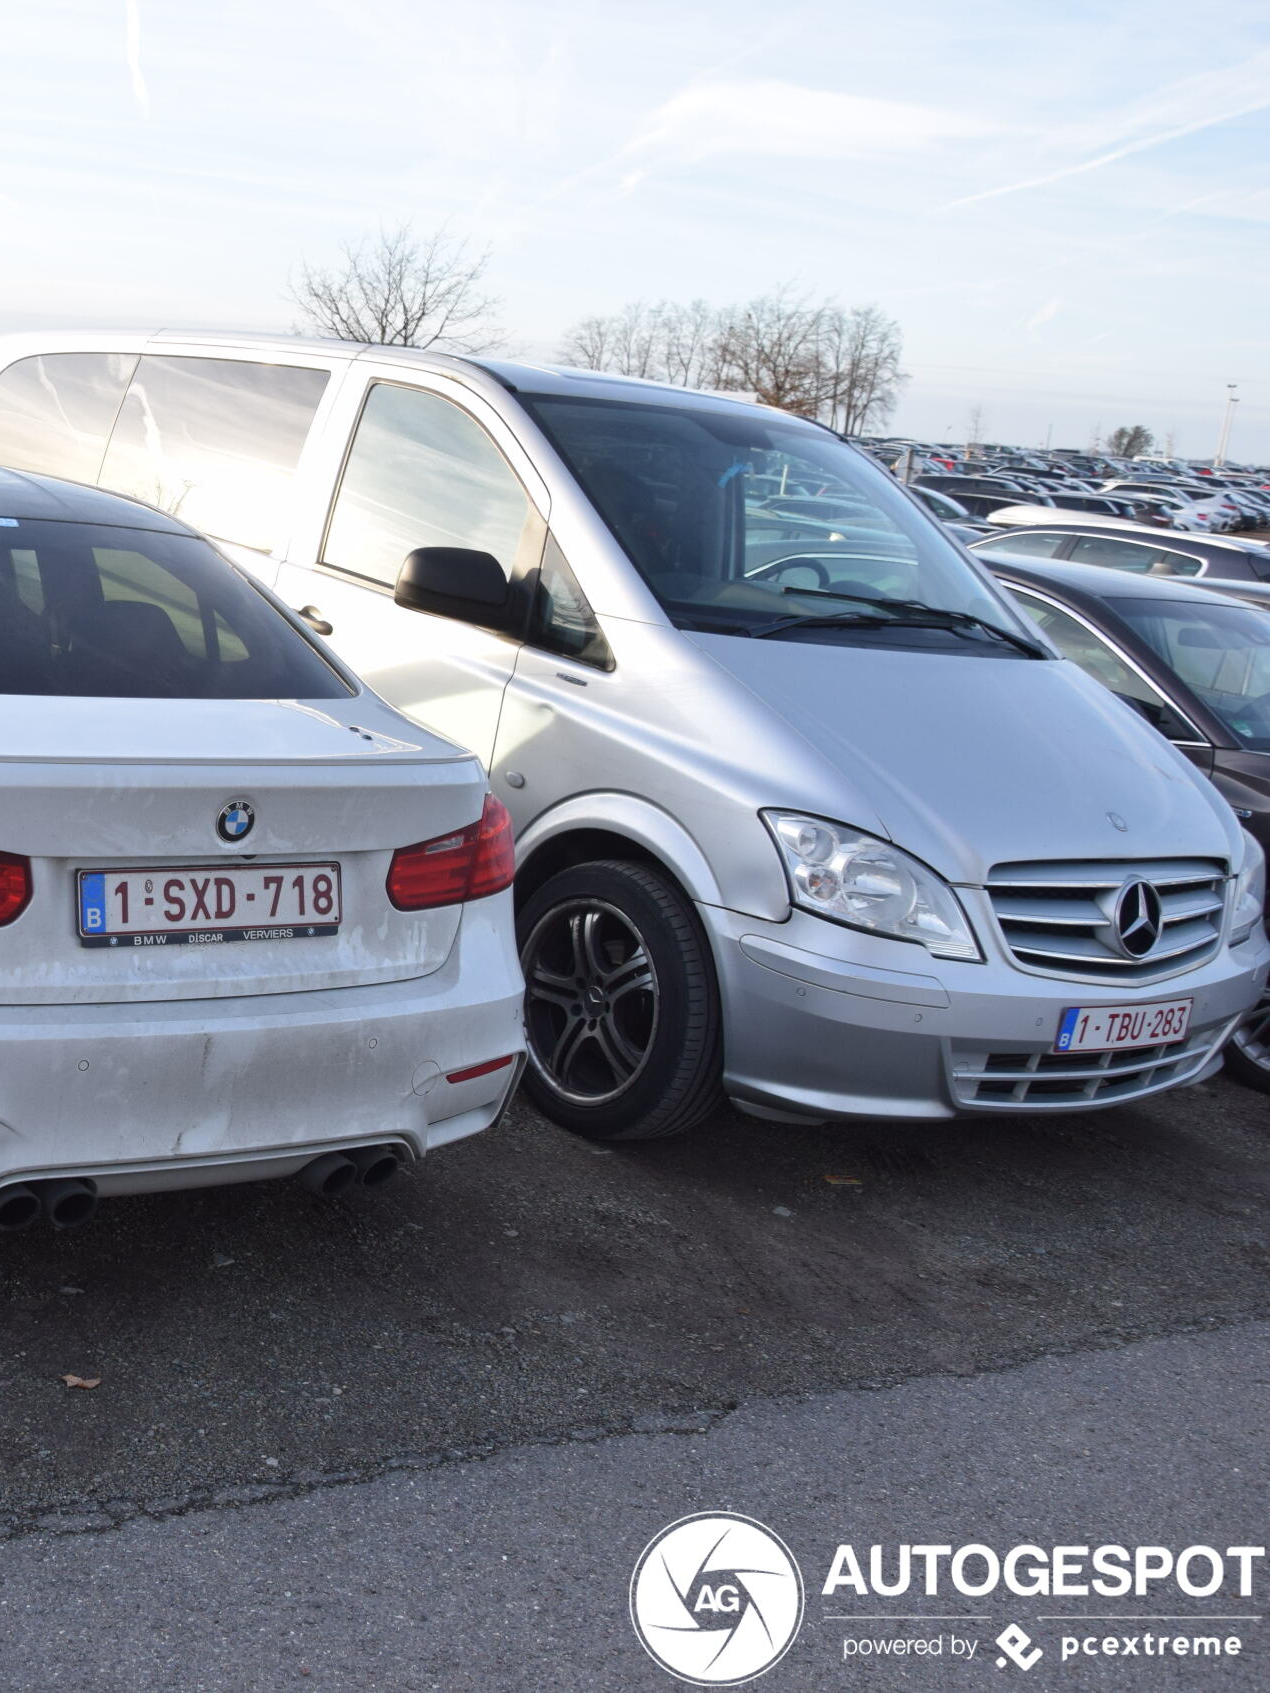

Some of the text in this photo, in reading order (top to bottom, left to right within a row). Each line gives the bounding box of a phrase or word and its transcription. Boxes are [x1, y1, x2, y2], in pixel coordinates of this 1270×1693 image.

[223, 802, 254, 816] BMW
[114, 874, 333, 924] 1-SXD-718
[87, 908, 102, 928] B
[134, 935, 167, 946] BMW
[243, 928, 294, 940] VERVIERS
[1078, 1006, 1187, 1043] 1-TBU-283
[1059, 1033, 1070, 1047] B
